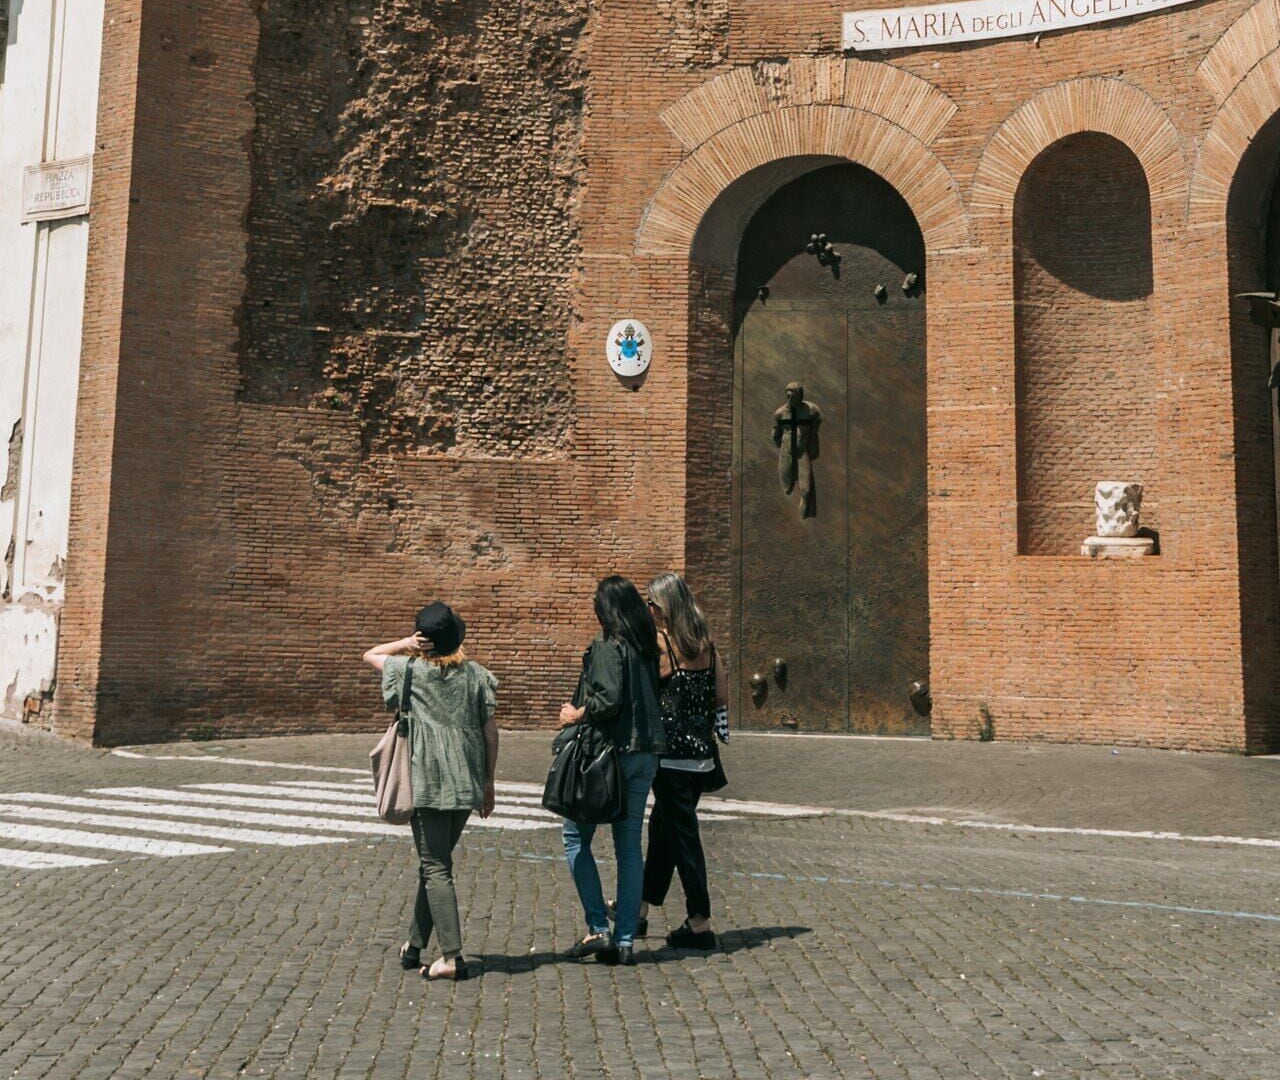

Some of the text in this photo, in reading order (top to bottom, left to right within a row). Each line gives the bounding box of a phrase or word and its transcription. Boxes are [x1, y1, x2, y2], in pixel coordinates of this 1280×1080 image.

[853, 19, 870, 43] S.
[880, 12, 965, 41] MARIA
[972, 11, 1022, 33] DEGLI
[46, 170, 73, 184] PIAZZA
[34, 188, 80, 203] REPUBBLICA
